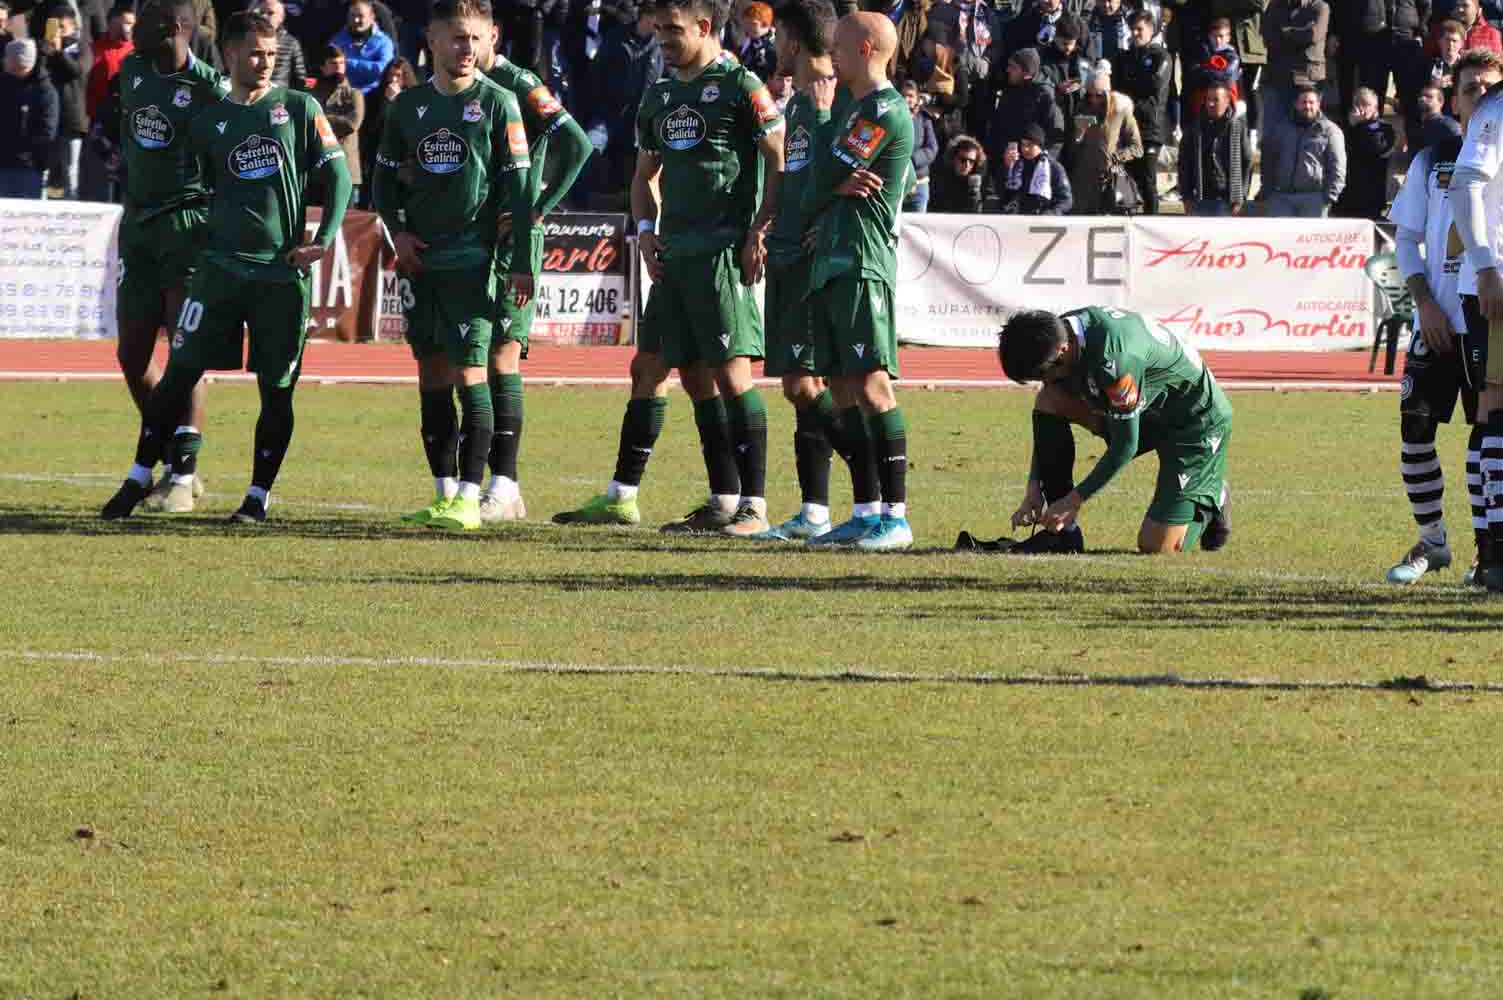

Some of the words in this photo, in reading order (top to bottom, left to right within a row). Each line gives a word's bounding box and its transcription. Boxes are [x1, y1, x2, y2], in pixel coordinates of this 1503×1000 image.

[665, 117, 699, 130] Estrella
[667, 128, 697, 140] Galicia
[235, 145, 277, 162] Estrella
[423, 141, 462, 153] Estrella
[238, 157, 277, 172] Galicia
[424, 152, 460, 164] Galicia
[557, 288, 619, 316] 12.40€
[177, 297, 204, 333] 10
